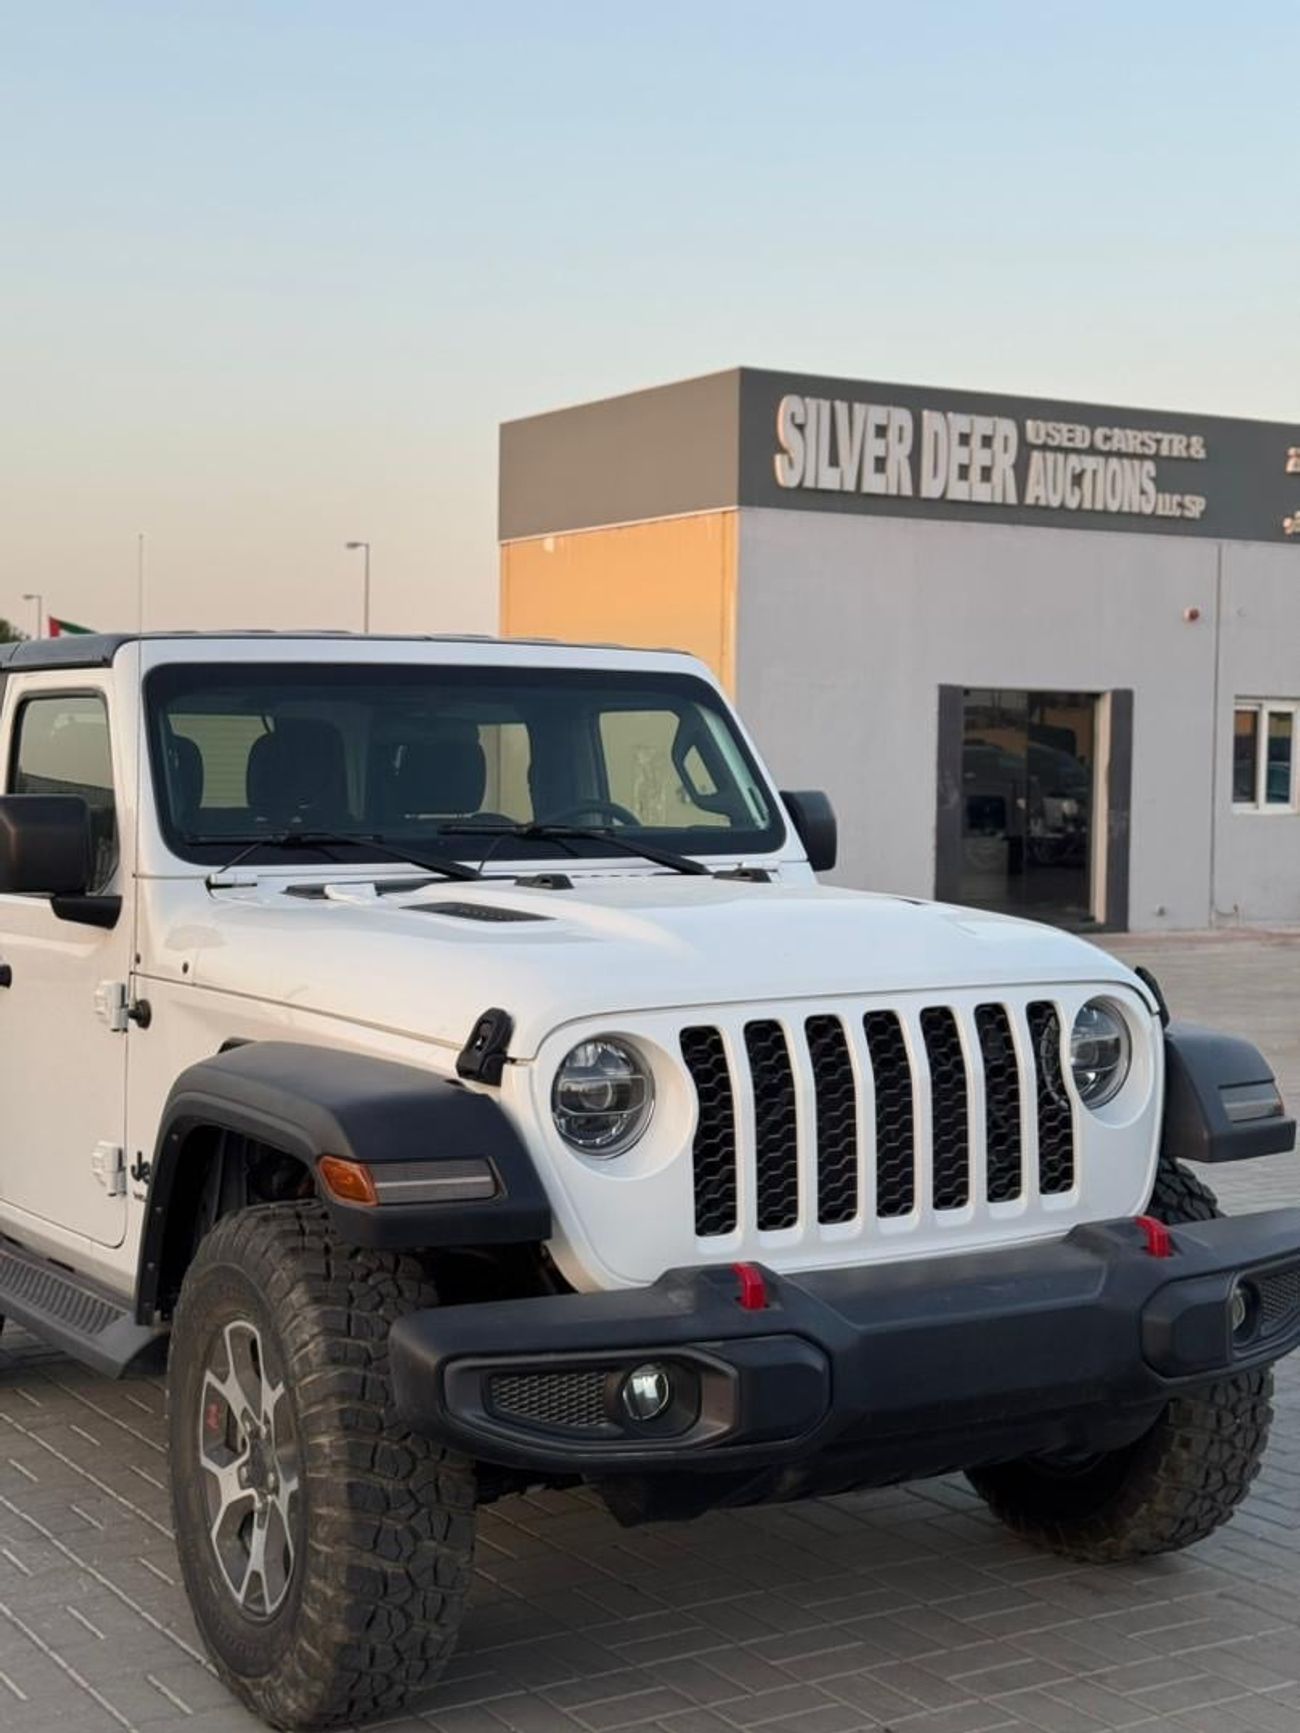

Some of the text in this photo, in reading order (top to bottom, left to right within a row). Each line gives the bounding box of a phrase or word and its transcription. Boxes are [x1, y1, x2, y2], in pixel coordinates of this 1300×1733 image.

[774, 394, 1019, 505] SILVER DEER
[1025, 419, 1091, 449] USED
[1024, 450, 1156, 515] AUCTIONS
